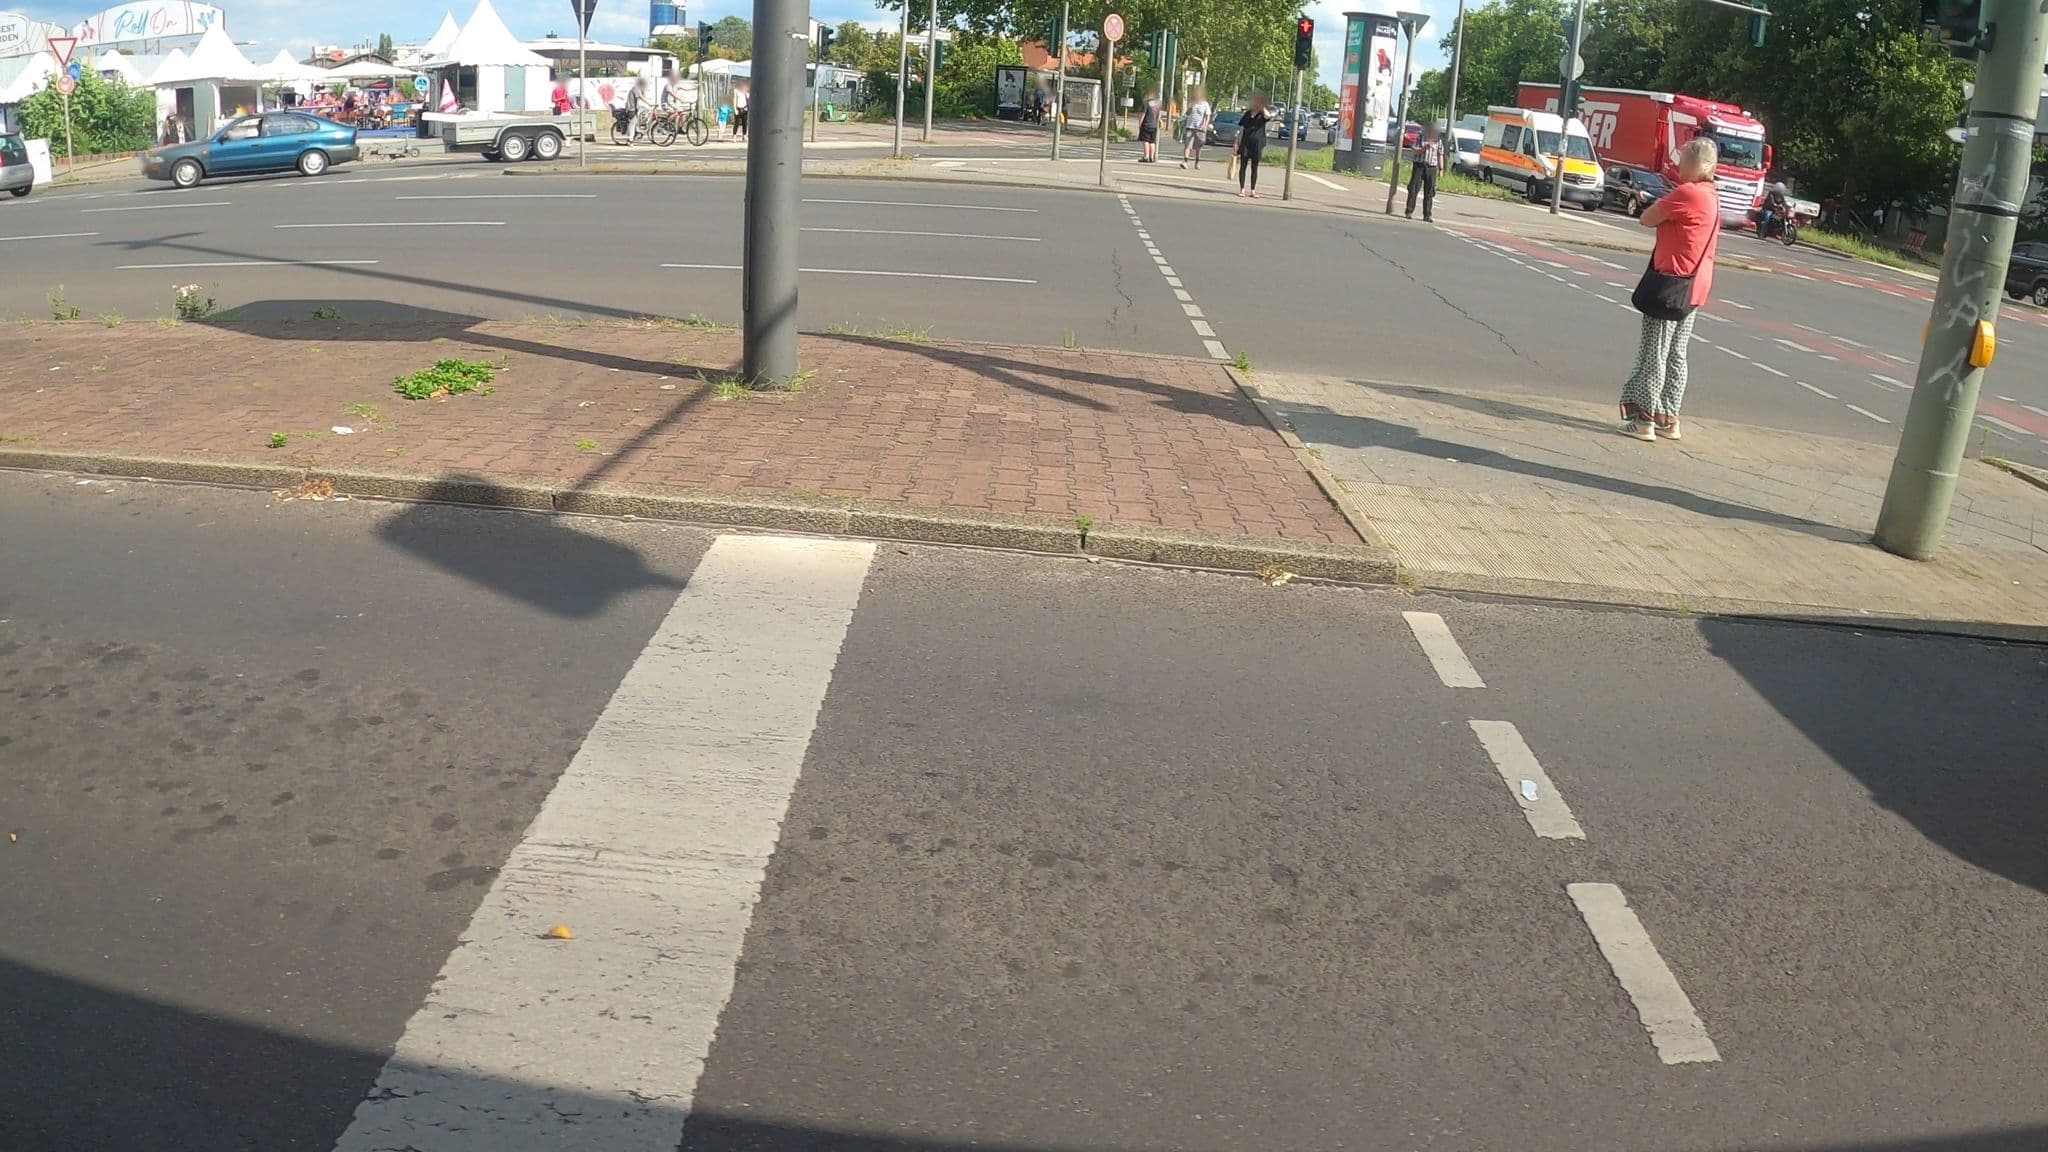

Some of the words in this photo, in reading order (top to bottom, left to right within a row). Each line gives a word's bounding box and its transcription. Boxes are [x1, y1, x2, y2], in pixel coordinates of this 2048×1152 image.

[0, 23, 16, 33] EST
[114, 9, 149, 38] Roll
[150, 8, 177, 35] On
